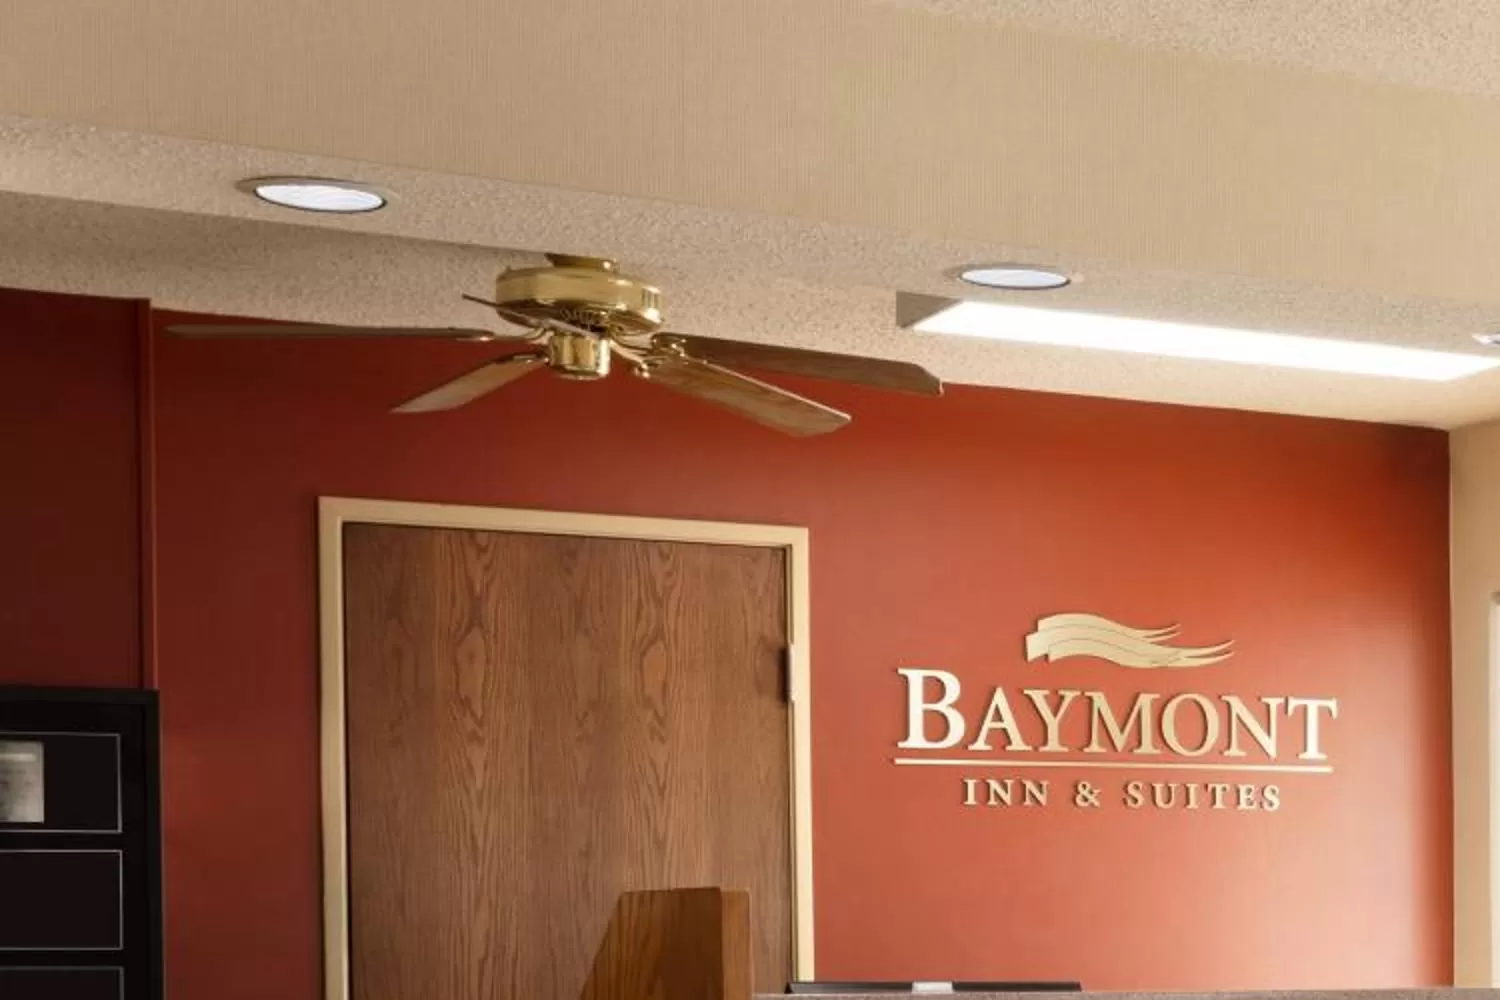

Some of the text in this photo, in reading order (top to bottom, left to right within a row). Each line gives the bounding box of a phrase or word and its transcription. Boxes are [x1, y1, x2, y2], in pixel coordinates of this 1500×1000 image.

[897, 666, 1339, 761] BAYMONT
[963, 778, 1281, 812] INN & SUITES
